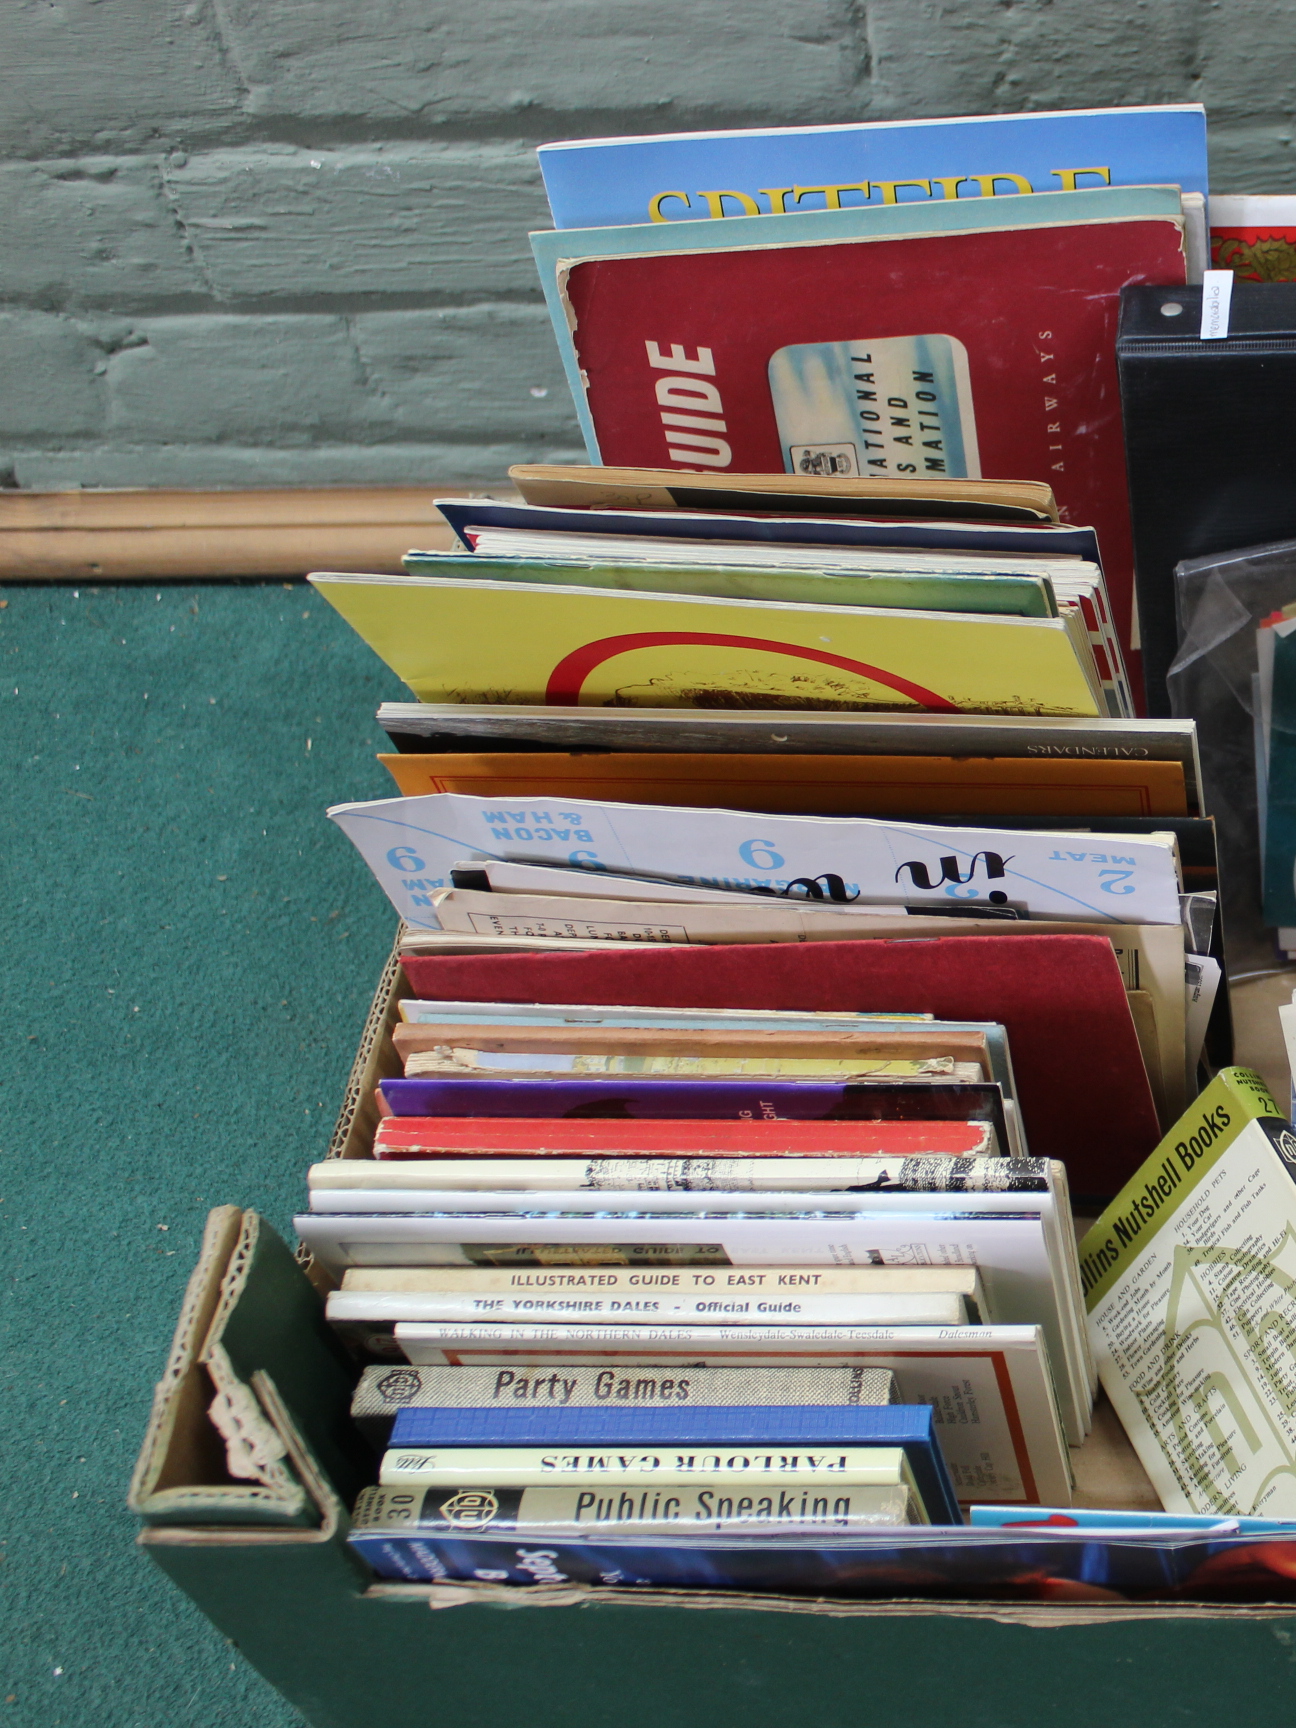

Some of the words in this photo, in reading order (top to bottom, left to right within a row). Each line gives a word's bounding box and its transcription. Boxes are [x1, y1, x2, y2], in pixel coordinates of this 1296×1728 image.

[645, 340, 733, 472] UIDE
[851, 352, 889, 478] ATIONAL
[1039, 330, 1065, 472] AIRWAYS
[887, 396, 913, 447] AND
[912, 370, 947, 478] MATION
[1027, 744, 1149, 757] CALENDARS
[482, 810, 555, 824] HAM
[558, 812, 583, 826] &
[492, 827, 595, 843] BACON
[386, 846, 426, 873] 9
[738, 838, 786, 870] 9
[1048, 850, 1137, 866] MEAT
[401, 878, 451, 891] AM
[895, 850, 1016, 905] in
[1099, 869, 1136, 895] 2
[759, 1100, 779, 1120] GHT
[1257, 1096, 1280, 1115] 27
[1112, 1157, 1182, 1249] Nutshell
[1174, 1105, 1231, 1172] Books
[1222, 1199, 1232, 1213] and
[1233, 1183, 1246, 1200] other
[1247, 1166, 1261, 1184] Cage
[1174, 1188, 1211, 1233] HOUSEHOLD
[1211, 1169, 1226, 1189] PETS
[1187, 1215, 1200, 1231] Your
[1198, 1204, 1210, 1218] Dog
[1191, 1222, 1203, 1238] Your
[1202, 1212, 1212, 1224] Cat
[1202, 1234, 1222, 1258] Tropical
[1221, 1222, 1232, 1236] Fish
[1231, 1211, 1241, 1224] and
[1240, 1198, 1251, 1212] Fish
[1251, 1181, 1266, 1199] Tanks
[1203, 1229, 1216, 1246] Birds
[1200, 1249, 1226, 1281] HOBBIES
[1213, 1259, 1230, 1280] Stamp
[1229, 1232, 1252, 1262] Collecting
[1217, 1266, 1234, 1286] Colour
[1234, 1232, 1263, 1268] Photography
[1222, 1269, 1241, 1293] Amateur
[1242, 1240, 1266, 1270] Dramatics
[1226, 1284, 1238, 1300] Tape
[1238, 1257, 1262, 1286] Recording
[1262, 1246, 1272, 1259] and
[1272, 1228, 1287, 1247] Hi-Fi
[510, 1274, 618, 1287] ILLUSTRATED
[628, 1274, 681, 1287] GUIDE
[692, 1274, 716, 1286] TO
[727, 1275, 767, 1286] EAST
[777, 1274, 823, 1286] KENT
[1095, 1302, 1114, 1327] HOUSE
[1117, 1283, 1130, 1301] AND
[1131, 1252, 1157, 1284] GARDEN
[473, 1299, 505, 1311] THE
[512, 1300, 604, 1312] YORKSHIRE
[610, 1300, 660, 1313] DALES
[695, 1301, 751, 1313] Official
[757, 1301, 802, 1313] Guide
[439, 1328, 503, 1340] WALKING
[510, 1328, 525, 1340] IN
[532, 1328, 559, 1340] THE
[566, 1329, 642, 1341] NORTHERN
[649, 1329, 693, 1341] DALES
[938, 1330, 993, 1341] Dalesman
[1243, 1337, 1261, 1360] SPORT
[1264, 1318, 1279, 1337] AND
[1128, 1370, 1146, 1392] FOOD
[1146, 1353, 1160, 1372] AND
[1160, 1329, 1181, 1355] DRINK
[1265, 1349, 1285, 1373] Modern
[1269, 1364, 1283, 1381] Judo
[493, 1370, 578, 1404] Party
[594, 1370, 692, 1401] Games
[1273, 1370, 1288, 1389] Party
[1160, 1432, 1175, 1451] ARTS
[1177, 1413, 1191, 1431] AND
[1192, 1385, 1217, 1414] CRAFTS
[540, 1455, 661, 1474] GAMES
[675, 1455, 850, 1473] PARLOUR
[1224, 1462, 1247, 1489] LIVING
[386, 1493, 416, 1521] 30
[575, 1491, 681, 1523] Public
[694, 1488, 852, 1530] Speaking
